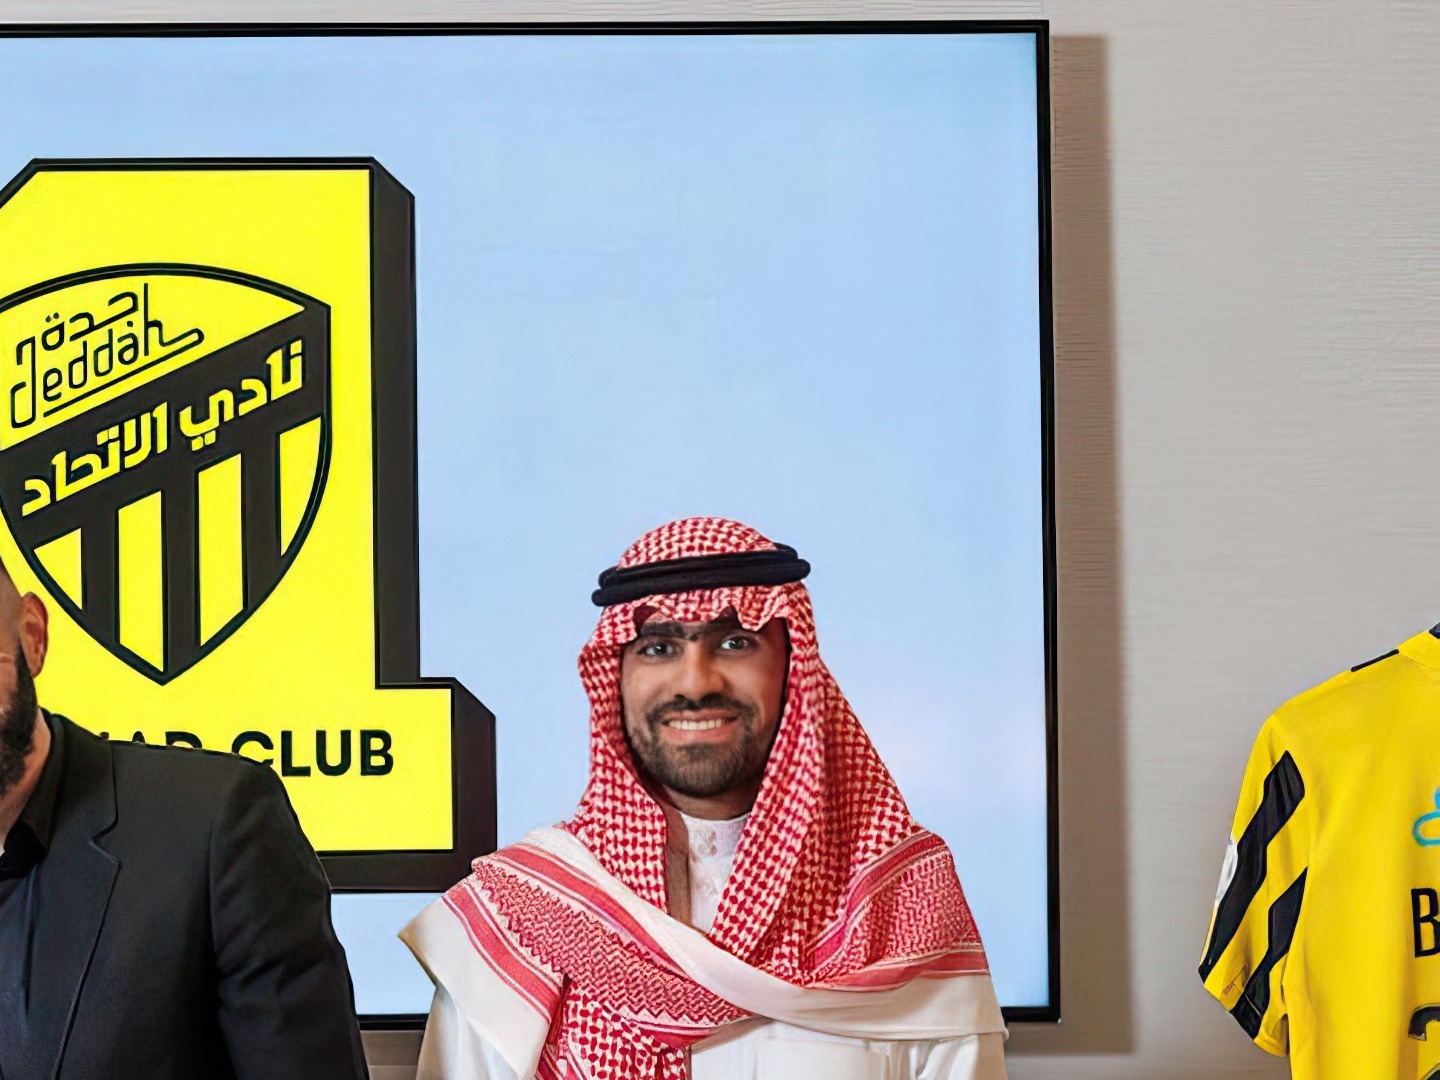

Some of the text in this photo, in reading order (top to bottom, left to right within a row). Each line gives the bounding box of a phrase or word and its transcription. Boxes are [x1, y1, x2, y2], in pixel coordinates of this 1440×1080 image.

[21, 338, 303, 517] نادي الاتحاد
[231, 729, 394, 777] CLUB
